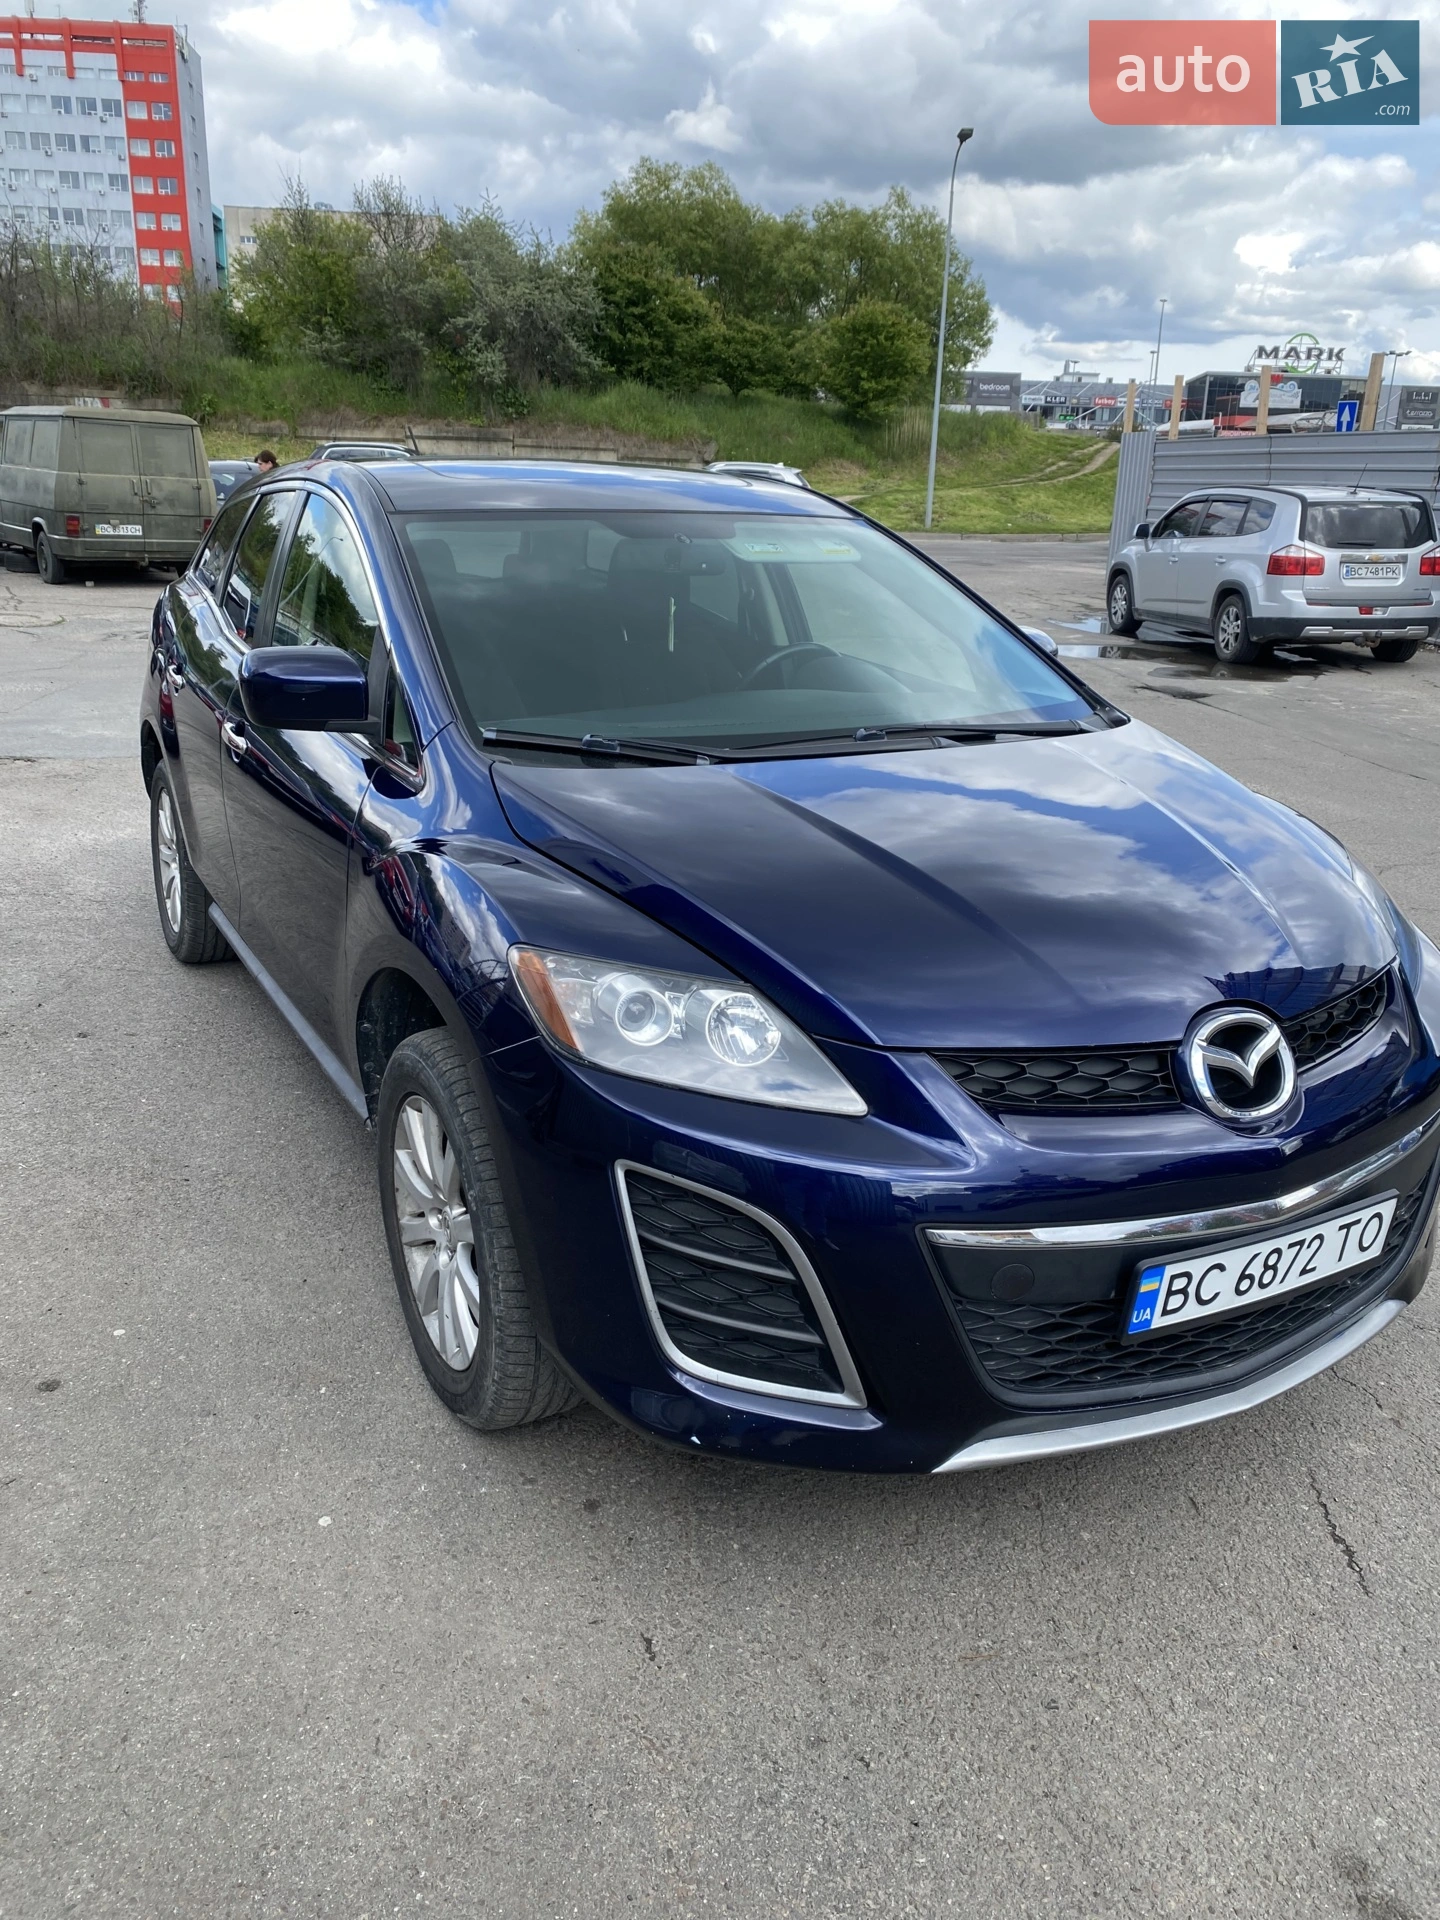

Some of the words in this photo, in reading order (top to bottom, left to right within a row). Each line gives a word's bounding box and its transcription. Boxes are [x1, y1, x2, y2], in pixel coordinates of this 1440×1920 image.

[1257, 345, 1346, 361] MARK
[979, 382, 1010, 391] bedroom
[1095, 396, 1116, 406] fatboy
[100, 525, 111, 534] BC
[129, 526, 141, 534] CH
[1350, 567, 1363, 576] BC
[1364, 567, 1385, 576] 7481
[1385, 567, 1398, 576] PK
[1160, 1262, 1227, 1317] BC
[1234, 1232, 1325, 1297] 6872
[1337, 1211, 1384, 1263] TO
[1132, 1307, 1151, 1324] UA
